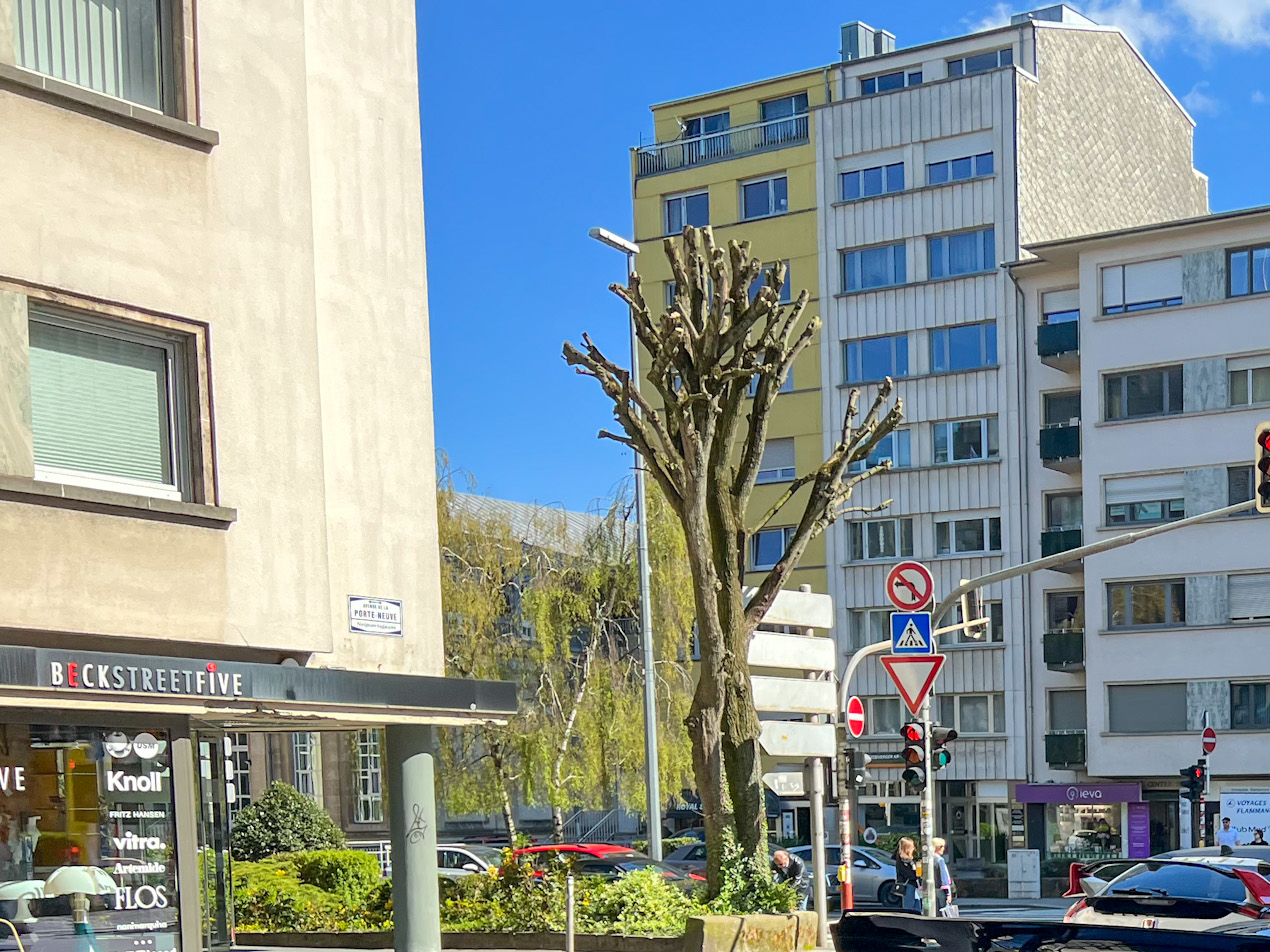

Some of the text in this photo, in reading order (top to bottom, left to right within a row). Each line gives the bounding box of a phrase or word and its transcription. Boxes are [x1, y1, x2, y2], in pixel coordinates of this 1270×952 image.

[354, 609, 398, 621] PORTE-NEUVE
[51, 661, 243, 696] BECKSTREETFIVE
[107, 770, 162, 792] Knoll
[1079, 789, 1102, 799] ieva
[109, 810, 166, 819] FRITZ HANSEN
[113, 831, 167, 850] vitra.
[113, 862, 166, 874] Artemide
[114, 885, 168, 910] FLOS
